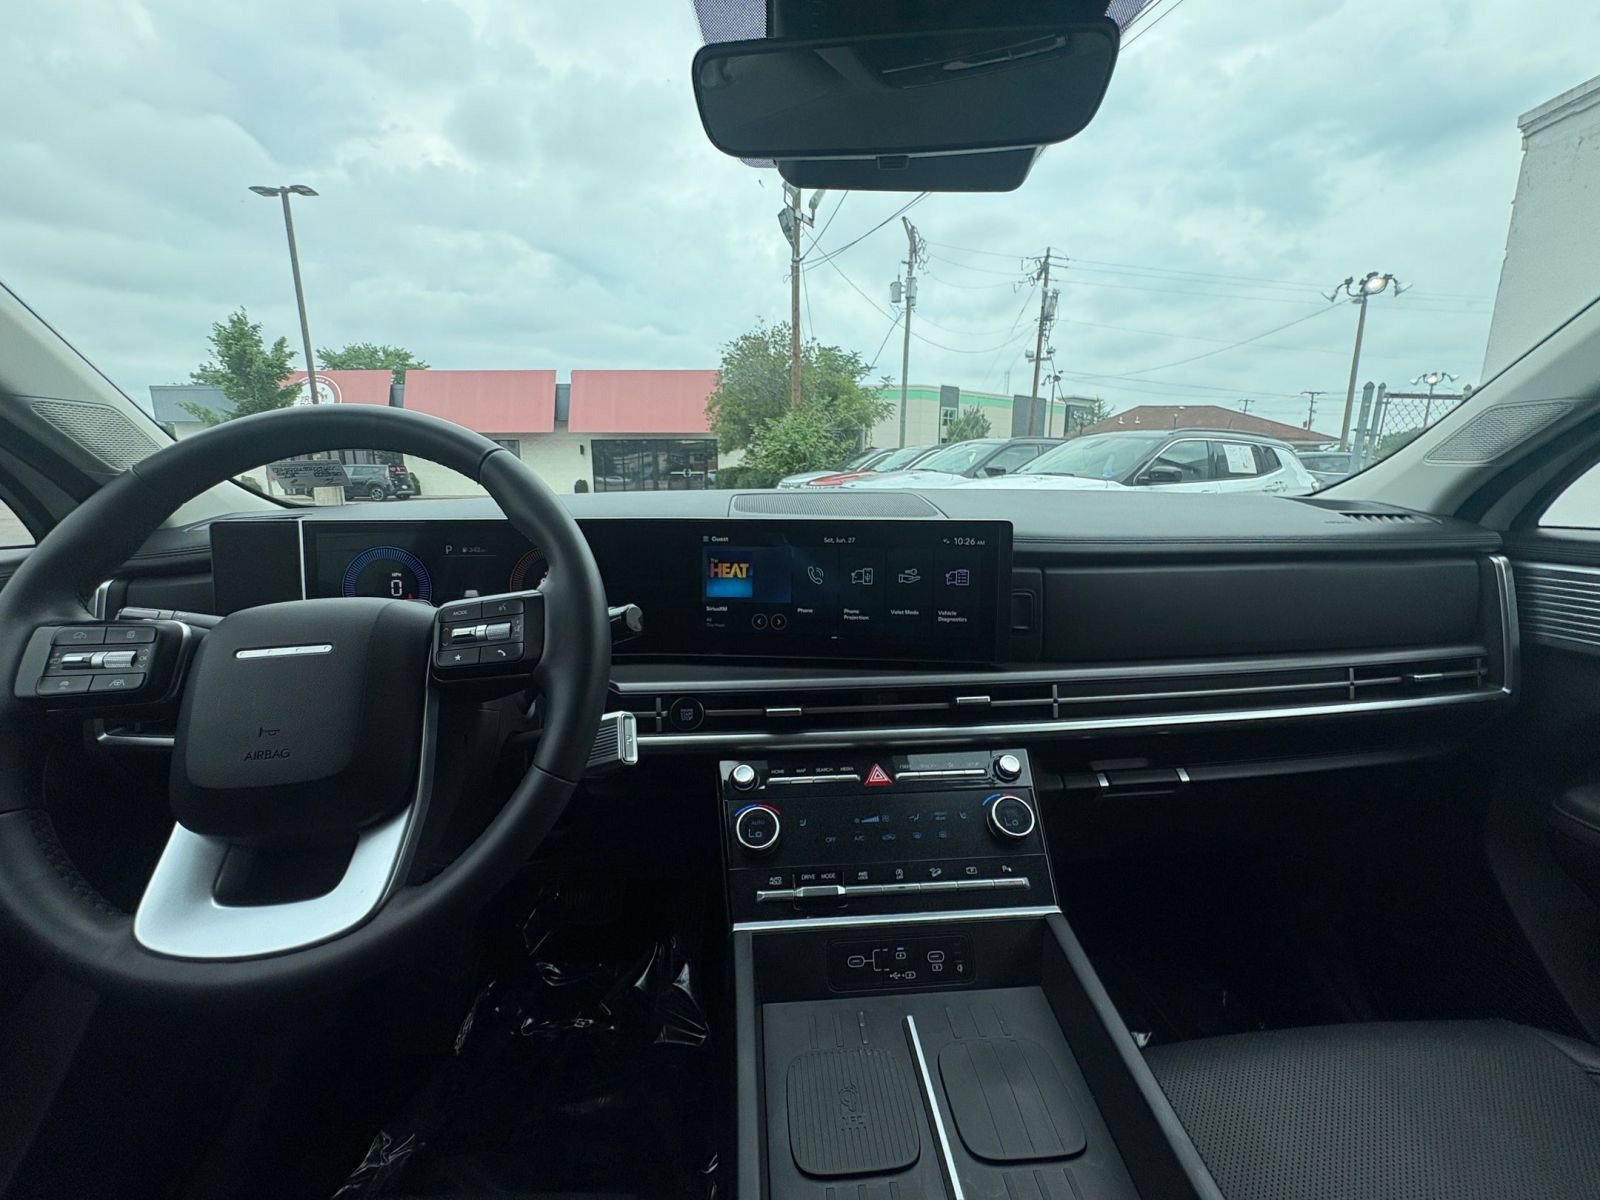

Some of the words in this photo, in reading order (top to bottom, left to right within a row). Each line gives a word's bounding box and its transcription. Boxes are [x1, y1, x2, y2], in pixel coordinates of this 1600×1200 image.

[954, 537, 976, 545] 10:26
[445, 545, 453, 554] P
[709, 563, 749, 578] HEAT
[391, 580, 402, 596] 0
[244, 748, 290, 760] AIRBAG
